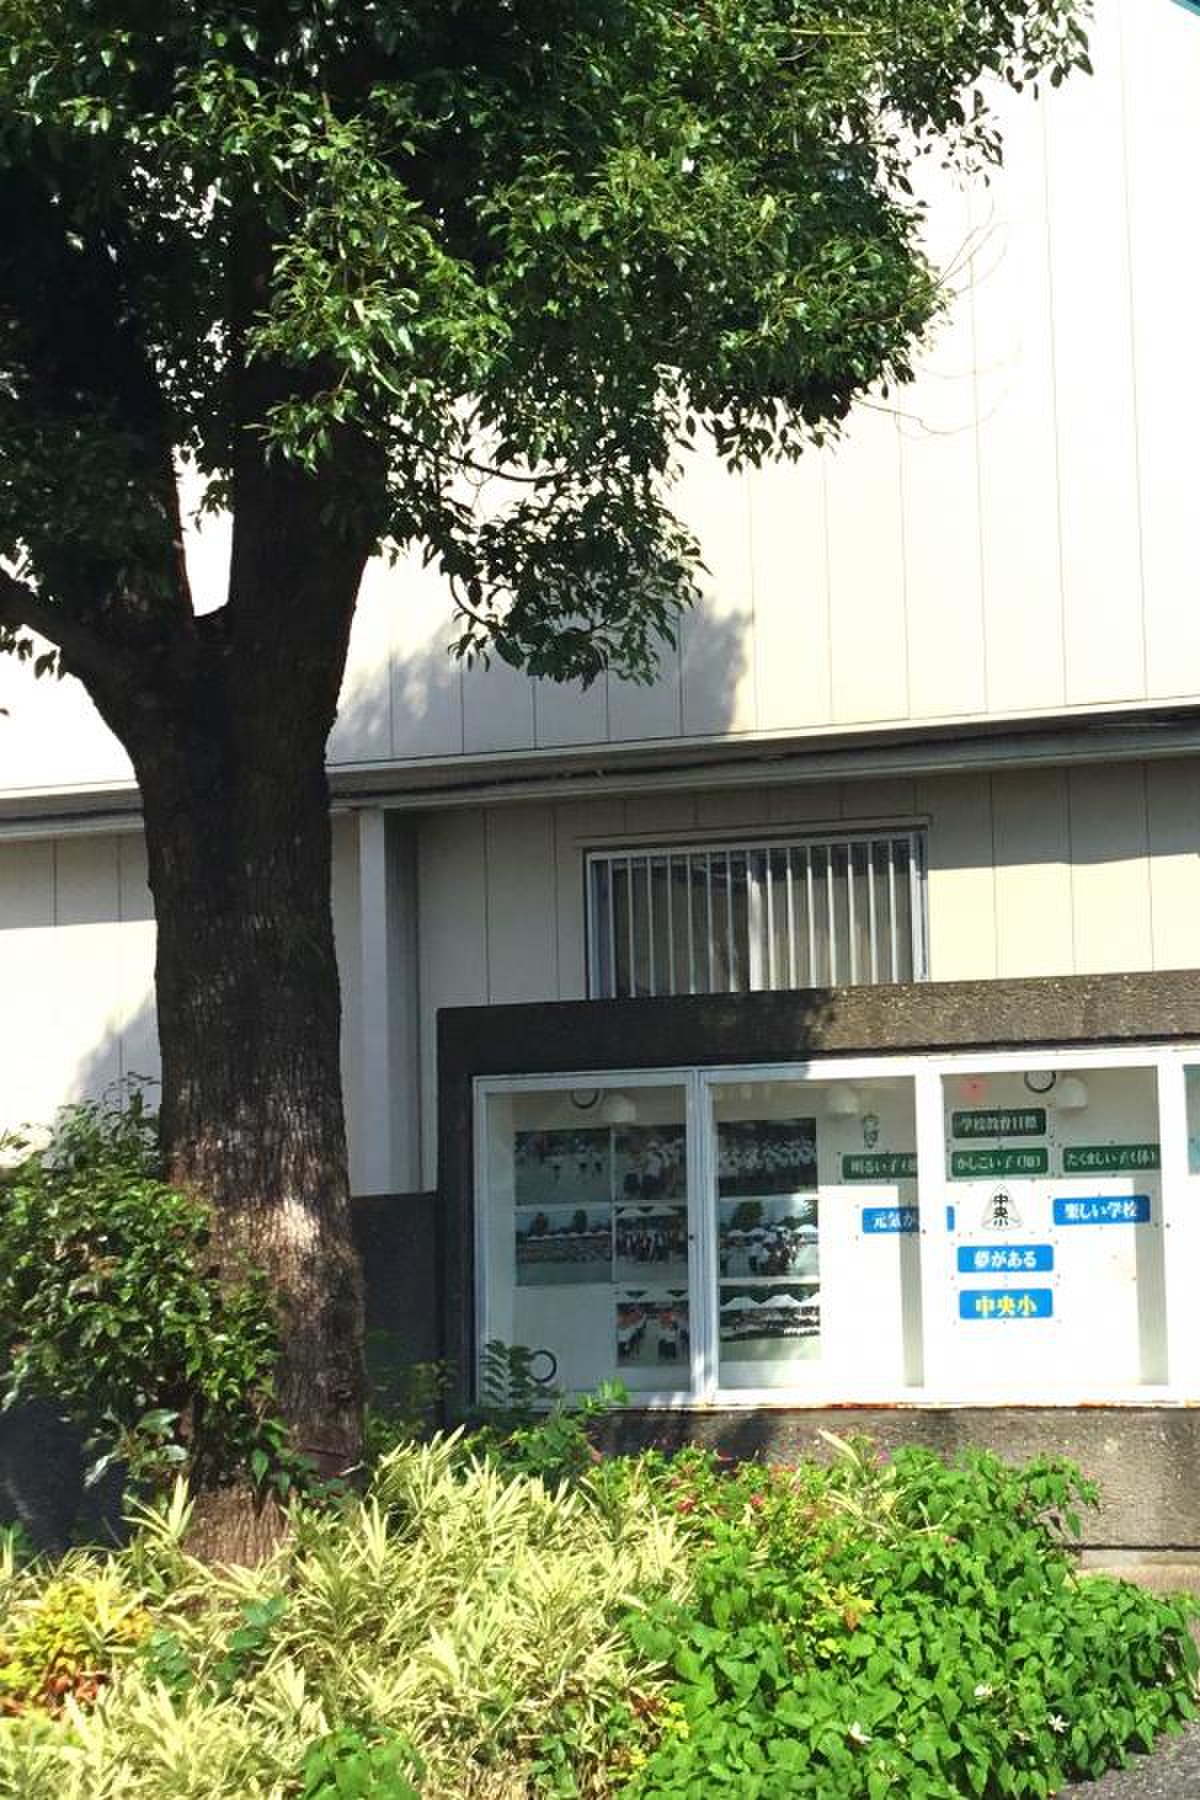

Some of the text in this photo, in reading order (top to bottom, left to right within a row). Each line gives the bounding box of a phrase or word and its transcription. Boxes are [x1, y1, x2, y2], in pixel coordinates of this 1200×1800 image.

[993, 1193, 1009, 1227] 中央小
[1064, 1201, 1137, 1219] 楽しい学校
[974, 1250, 1036, 1269] 夢がある
[975, 1295, 1037, 1317] 中央小
